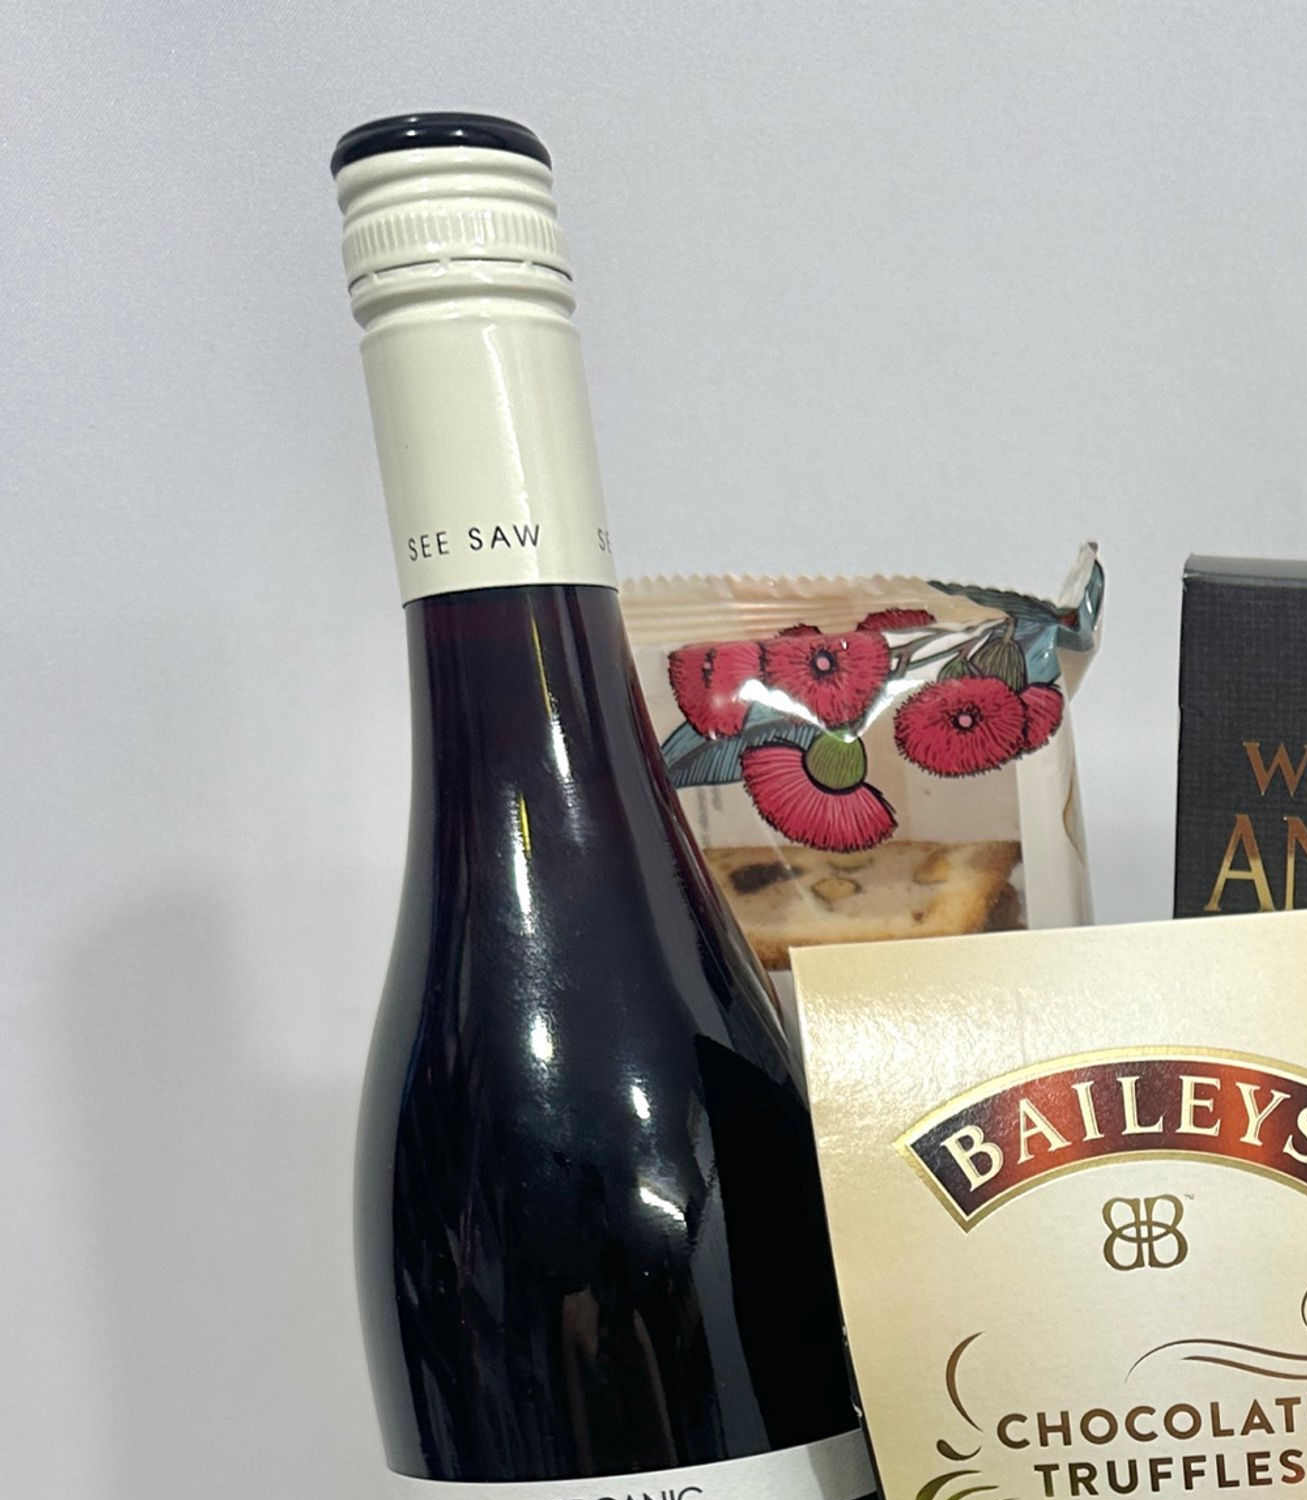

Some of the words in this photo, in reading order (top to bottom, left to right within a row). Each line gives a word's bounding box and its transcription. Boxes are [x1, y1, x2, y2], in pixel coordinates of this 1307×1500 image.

[408, 531, 449, 561] SEE
[468, 523, 541, 551] SAW
[1033, 1449, 1307, 1498] TRUFFLES
